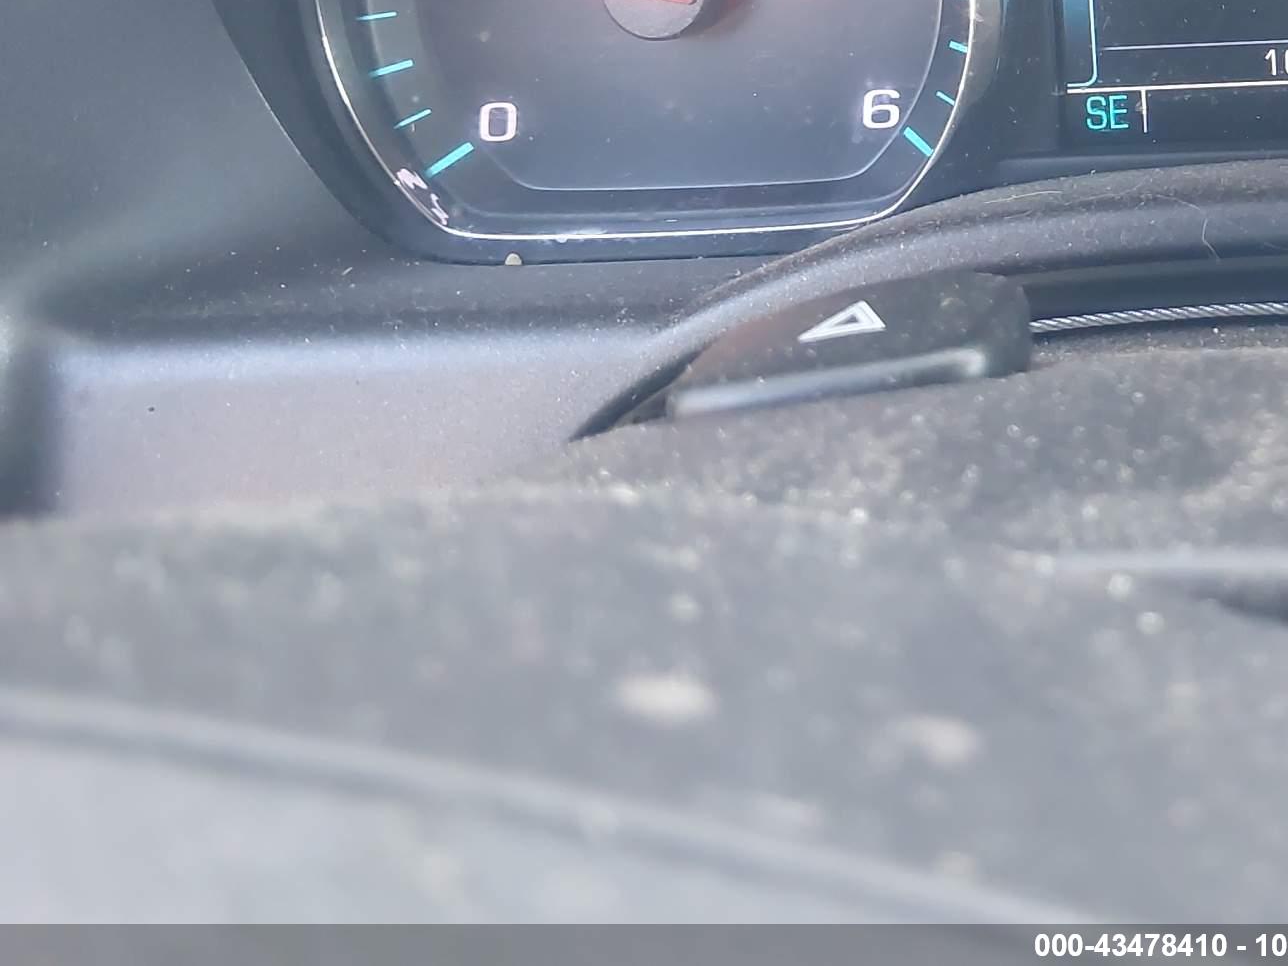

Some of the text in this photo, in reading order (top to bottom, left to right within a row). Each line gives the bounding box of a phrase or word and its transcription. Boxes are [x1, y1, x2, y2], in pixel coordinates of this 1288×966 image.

[479, 103, 516, 141] 0
[863, 89, 901, 129] 6
[1087, 95, 1129, 130] SE
